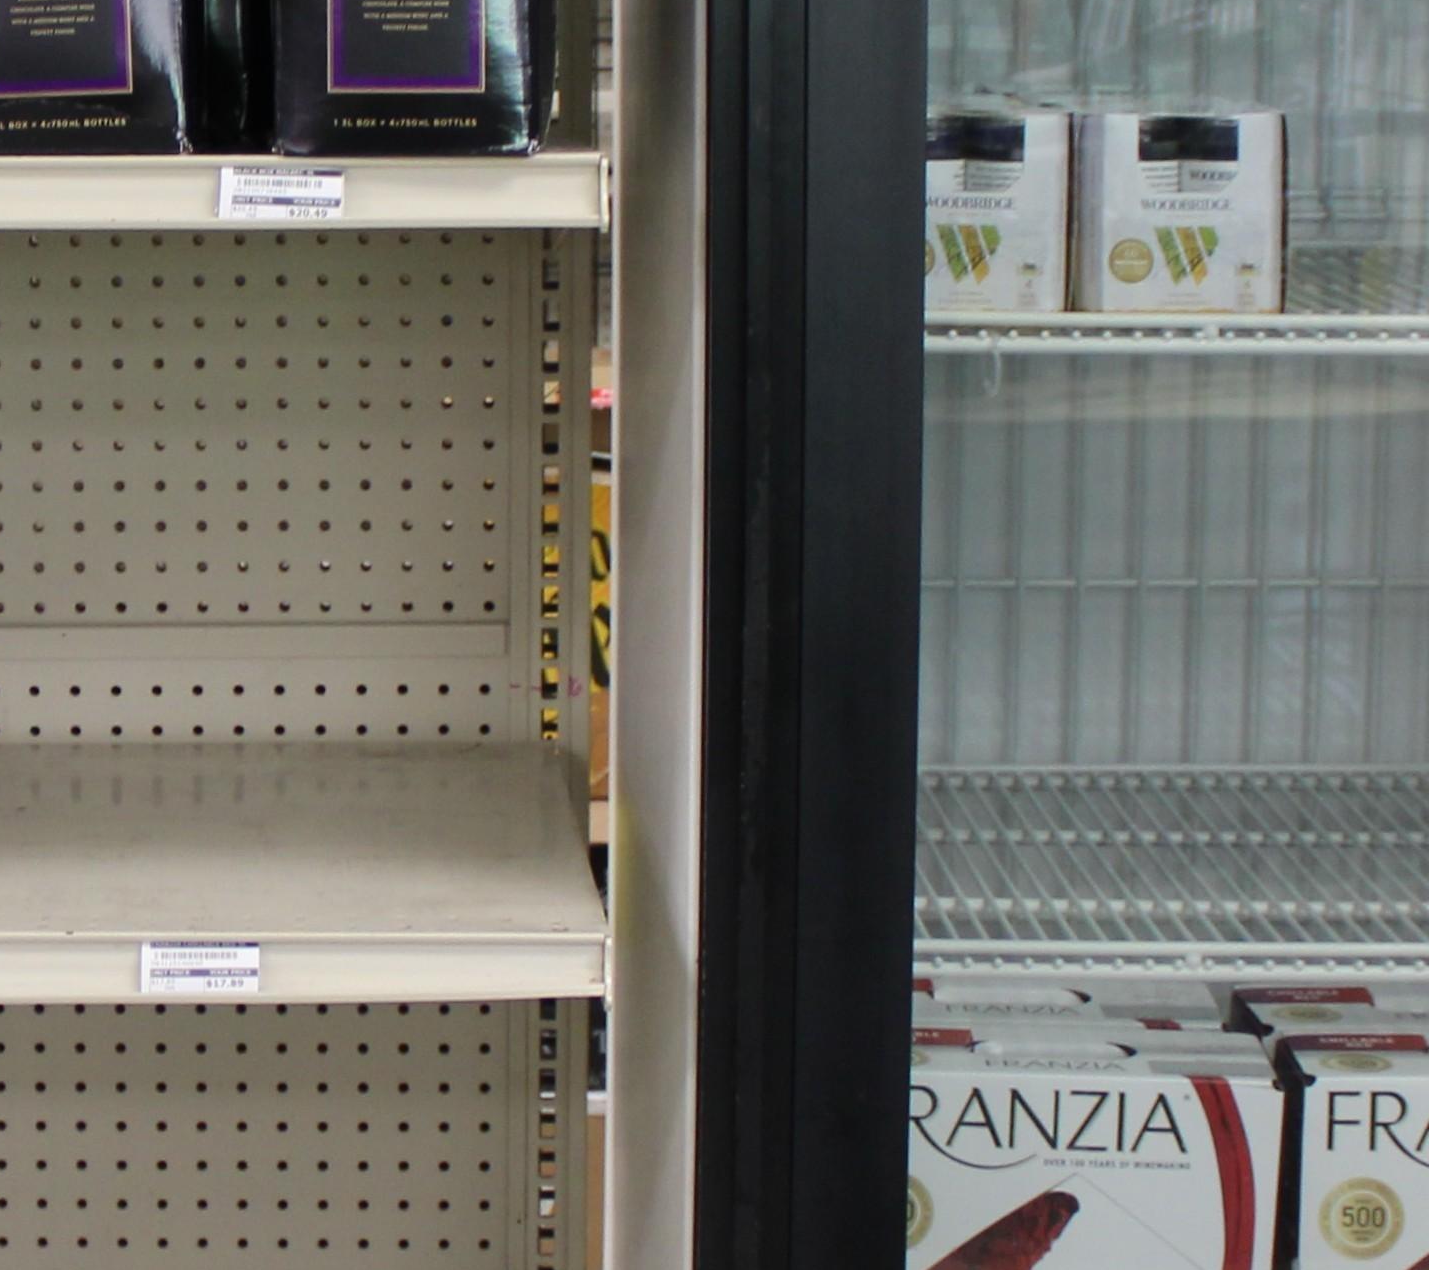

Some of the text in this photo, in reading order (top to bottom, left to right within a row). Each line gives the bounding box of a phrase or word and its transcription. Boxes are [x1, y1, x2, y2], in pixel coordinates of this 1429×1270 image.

[83, 116, 127, 127] BOTTLES
[434, 117, 477, 127] BOTTLES
[909, 1085, 1187, 1170] RANZIA
[1342, 1205, 1385, 1228] 500
